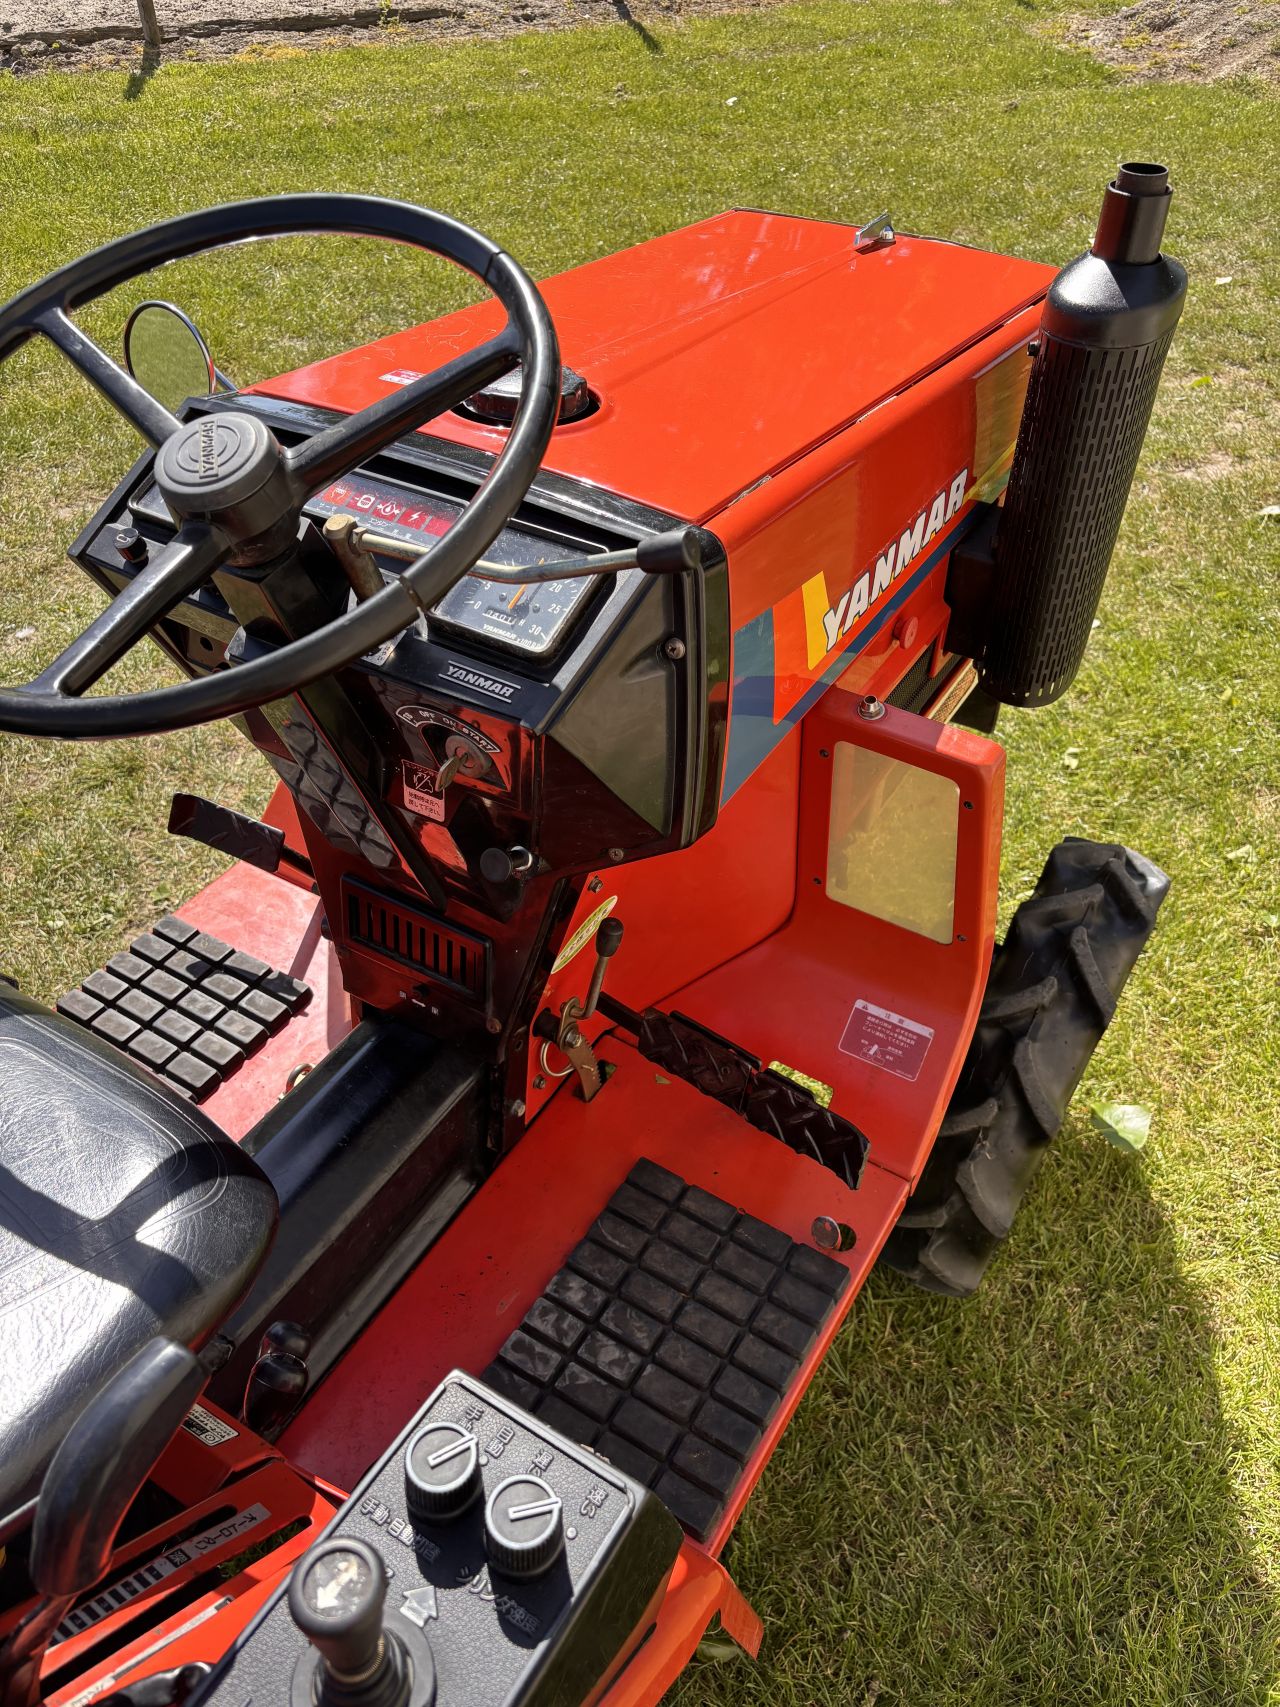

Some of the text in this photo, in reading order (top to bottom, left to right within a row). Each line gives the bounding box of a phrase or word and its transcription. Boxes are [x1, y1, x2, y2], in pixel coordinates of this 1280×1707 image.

[202, 423, 215, 474] YANMAR
[823, 468, 968, 651] YANMAR
[549, 583, 562, 592] 20
[474, 601, 480, 609] 0
[548, 604, 560, 614] 25
[483, 624, 516, 639] YANMAR
[529, 625, 541, 634] 30
[446, 665, 514, 697] YANMAR
[418, 710, 435, 718] OFF
[442, 717, 456, 727] ON
[463, 728, 494, 750] START
[485, 1426, 515, 1458] 自動
[579, 1484, 608, 1518] 速い
[455, 1566, 541, 1635] シリンダ速度
